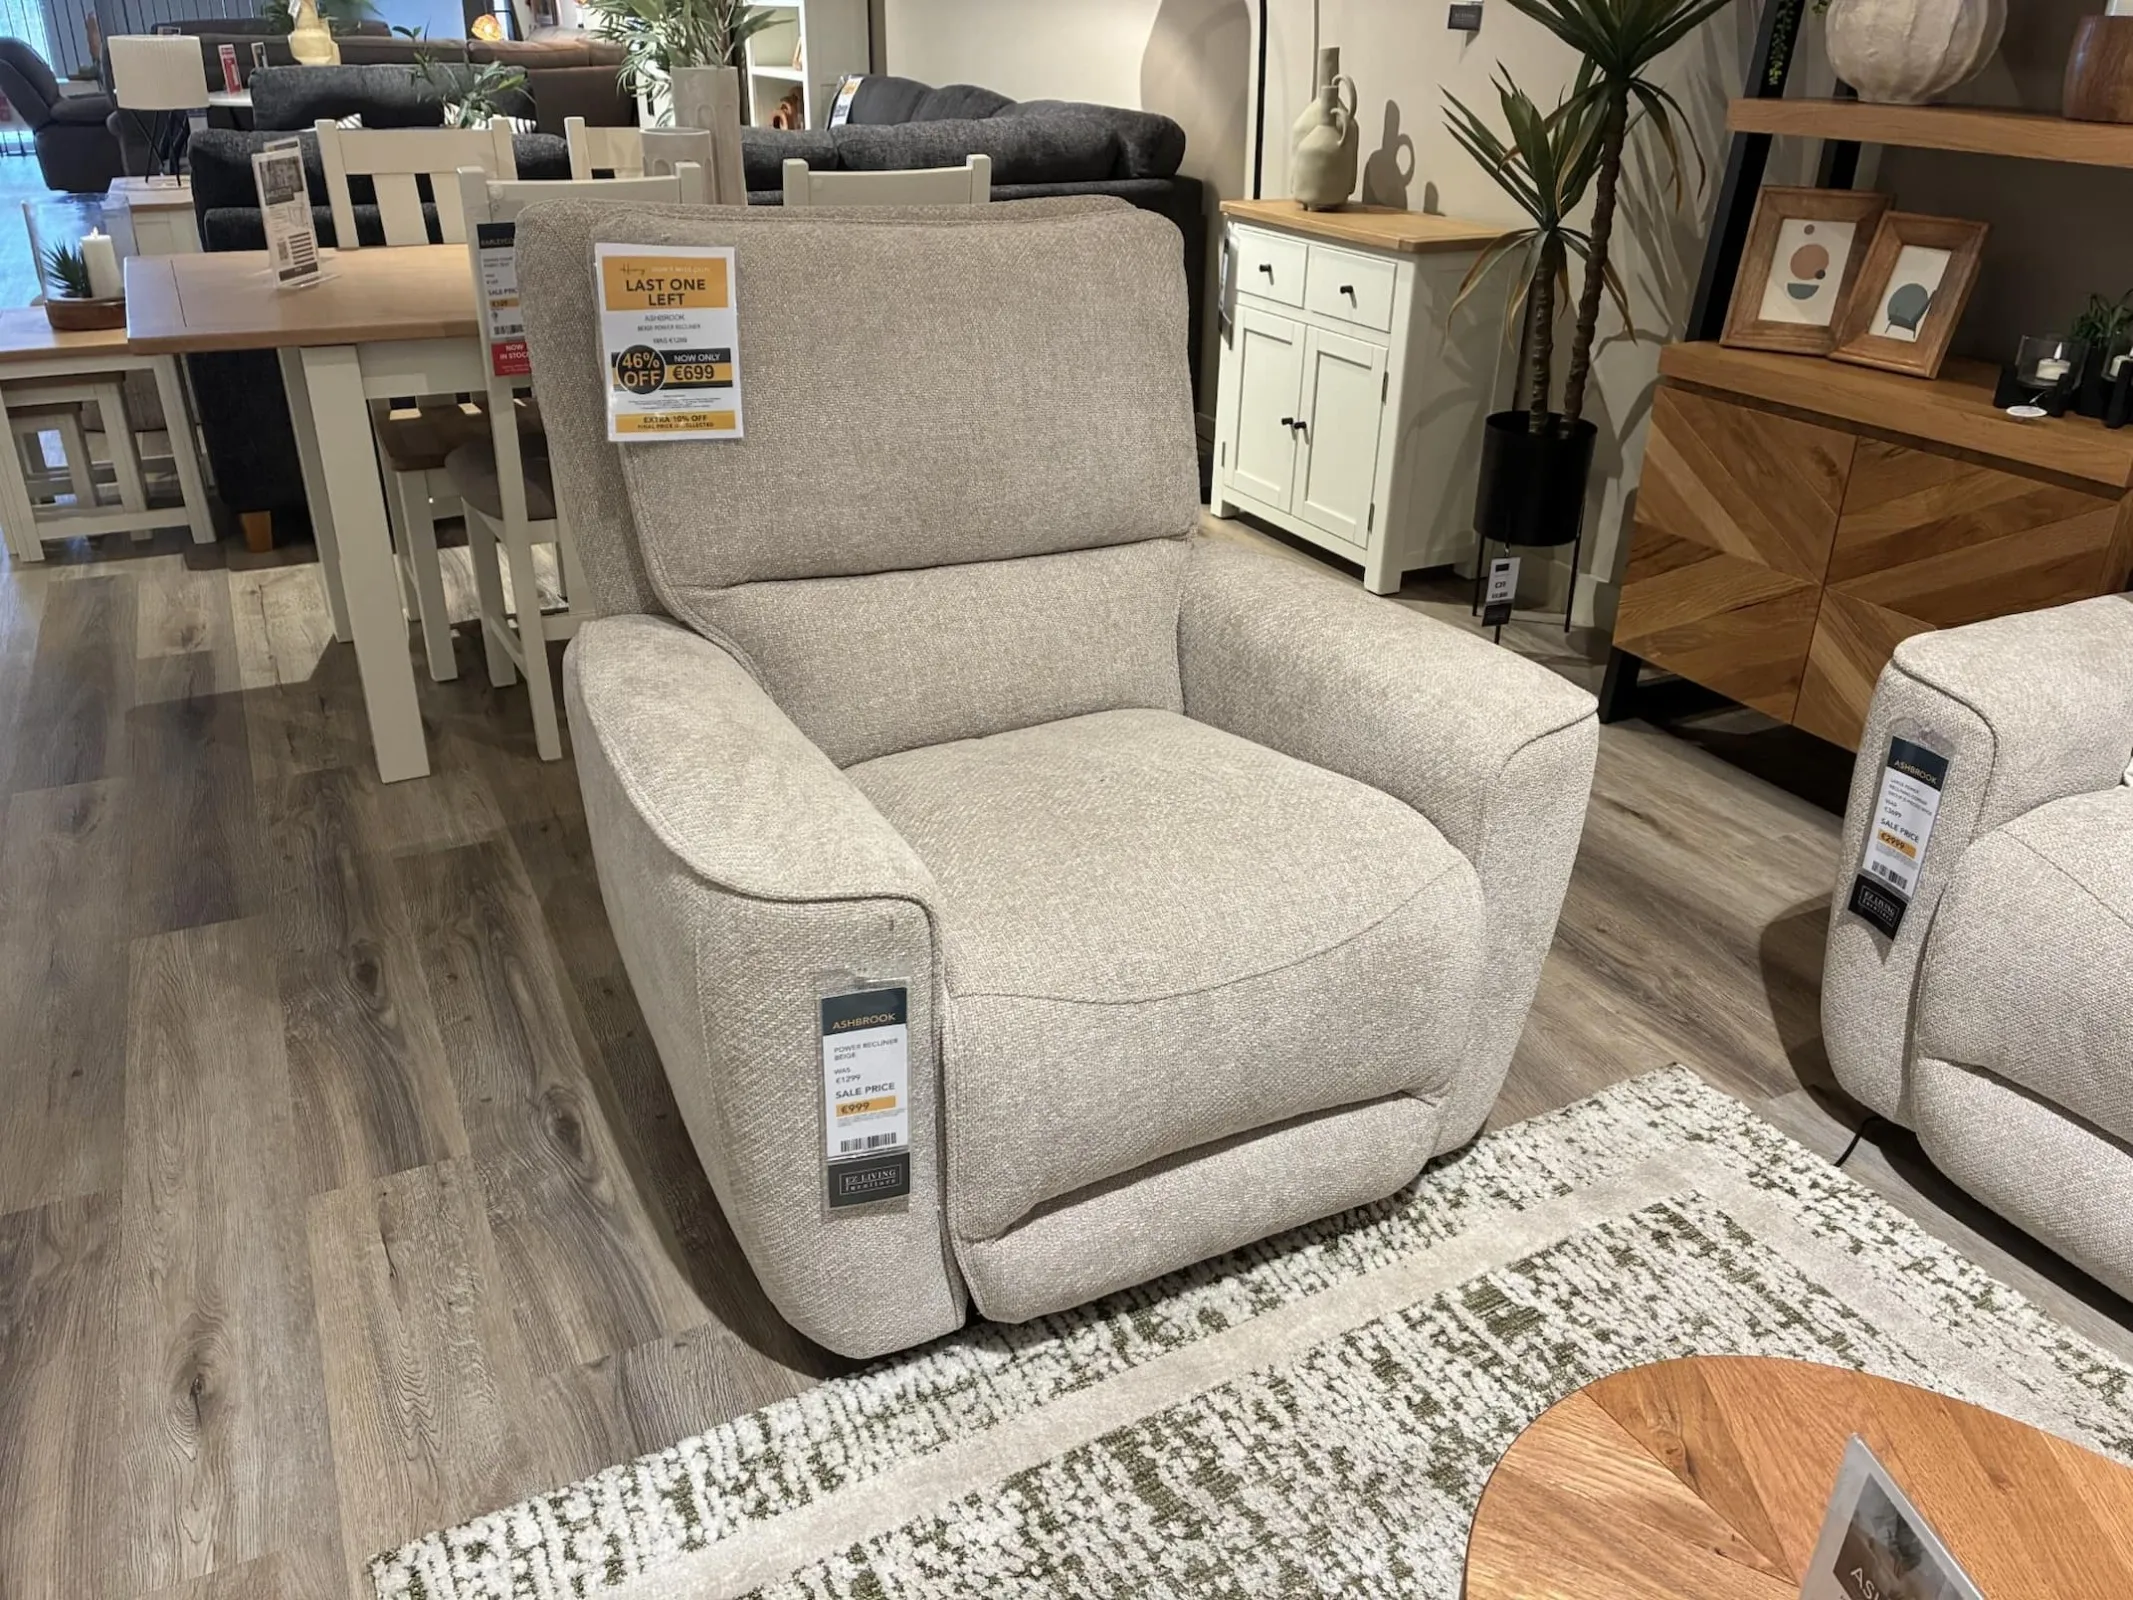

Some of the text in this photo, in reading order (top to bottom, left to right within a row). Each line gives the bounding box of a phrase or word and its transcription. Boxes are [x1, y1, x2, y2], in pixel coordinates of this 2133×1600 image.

[626, 278, 706, 292] LAST ONE
[648, 293, 685, 306] LEFT
[505, 343, 524, 351] NOW
[508, 351, 528, 359] STOC
[622, 351, 660, 369] 46%
[674, 352, 720, 363] NOW ONLY
[624, 370, 661, 387] OFF
[672, 364, 715, 381] €699
[1894, 760, 1937, 785] ASHBROOK
[1881, 818, 1919, 842] SALE PRICE
[1880, 832, 1905, 850] €2999
[832, 1013, 896, 1030] ASHBROOK
[834, 1038, 898, 1053] POWER RECLINER
[834, 1052, 856, 1061] BEIGE
[834, 1067, 851, 1075] WAS
[835, 1074, 861, 1084] €1299
[835, 1082, 895, 1100] SALE PRICE
[841, 1101, 870, 1114] €999
[861, 1169, 896, 1182] LIVING
[1850, 1567, 1880, 1600] AS
